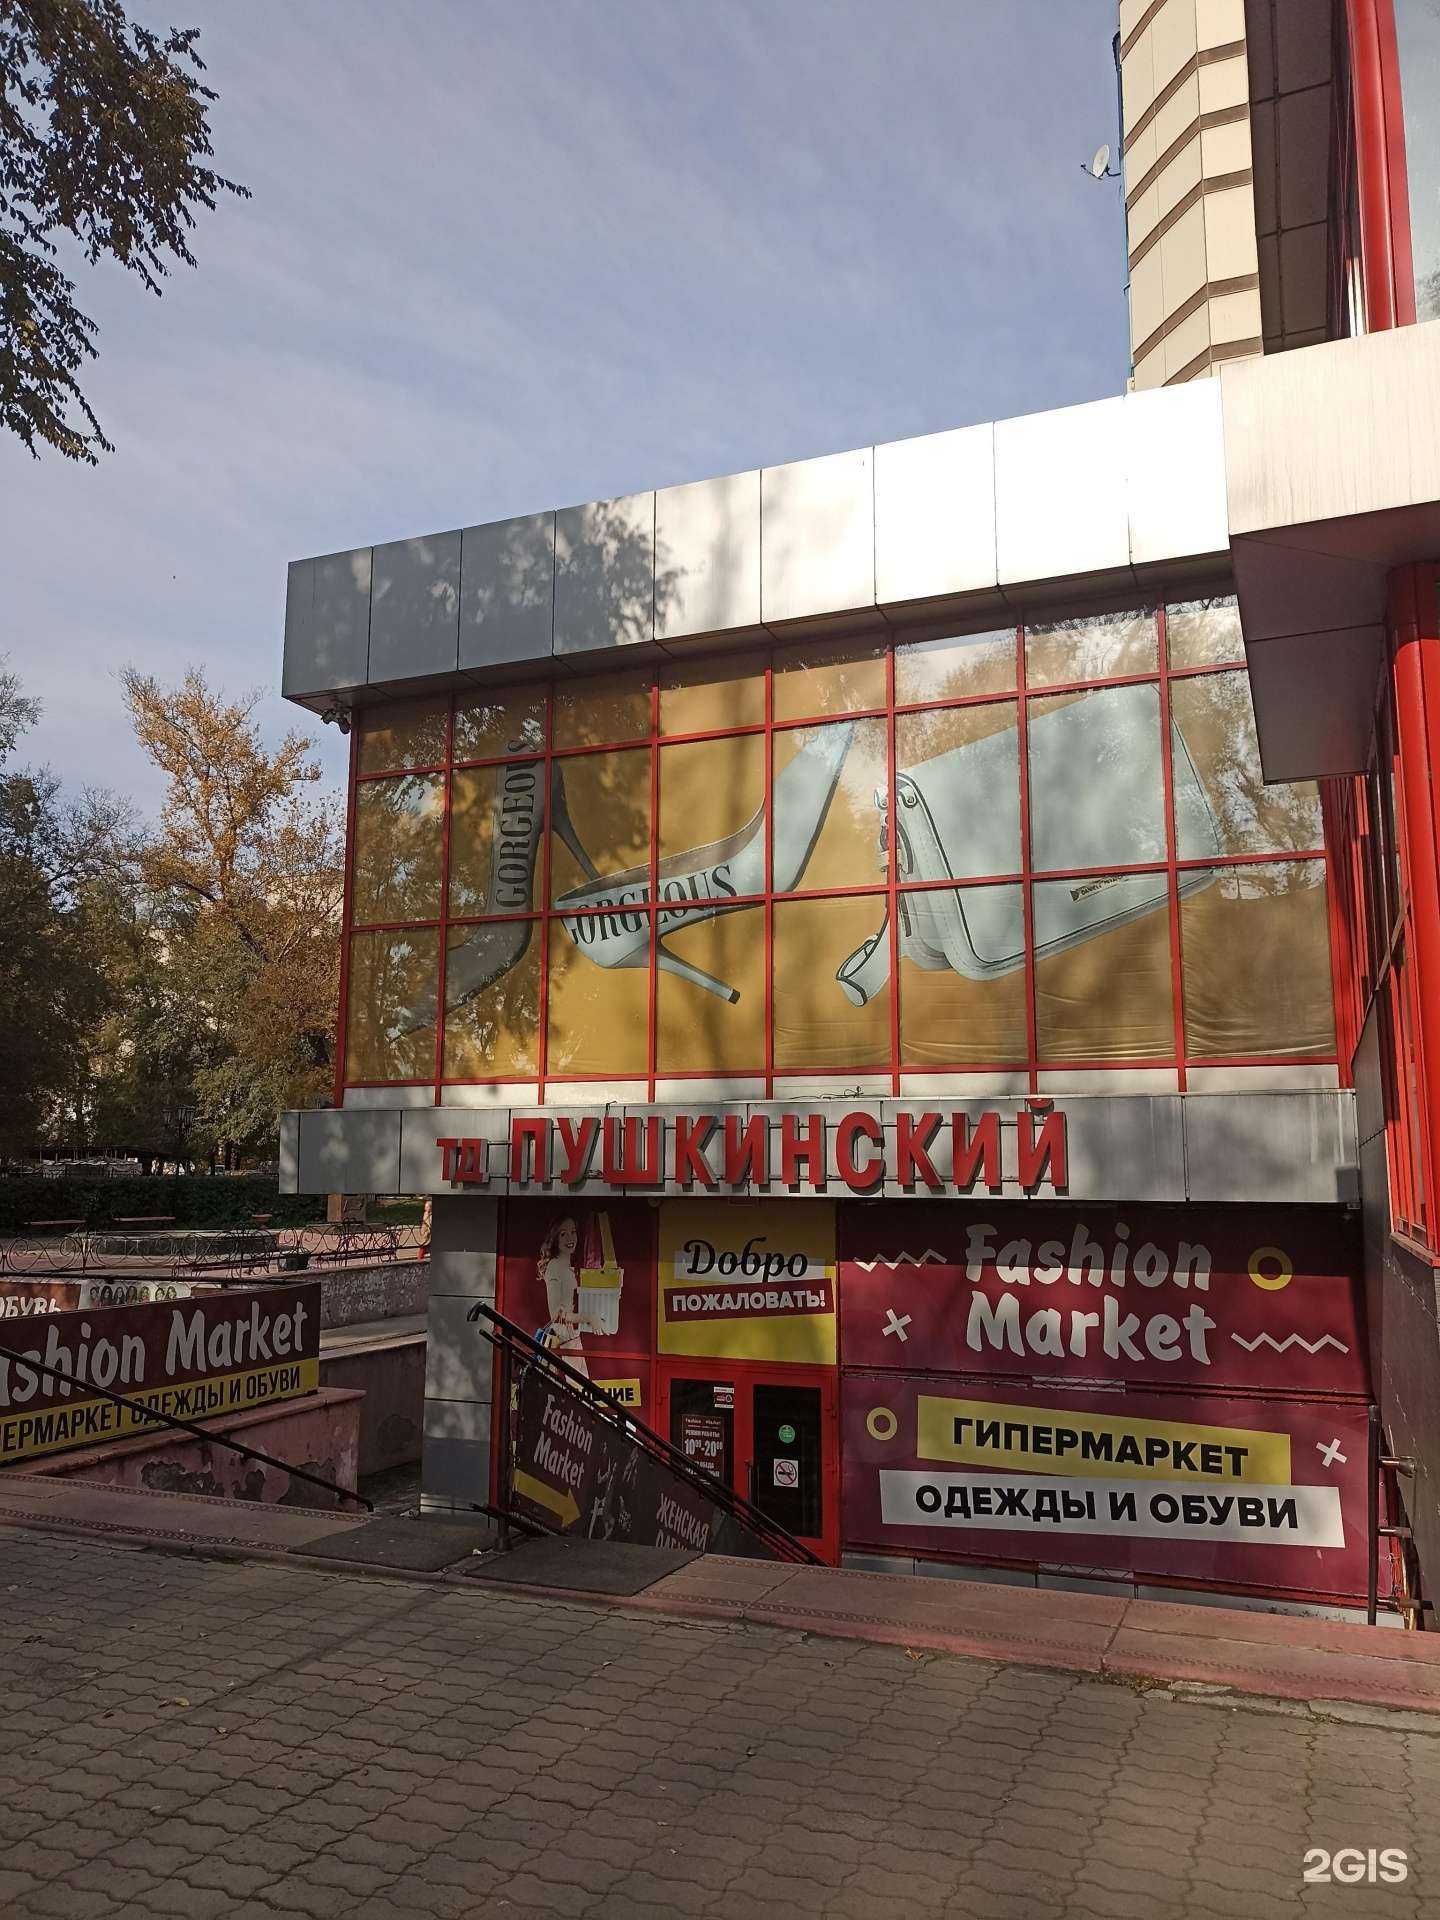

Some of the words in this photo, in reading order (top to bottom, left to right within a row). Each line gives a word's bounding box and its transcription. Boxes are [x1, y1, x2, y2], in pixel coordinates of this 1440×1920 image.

[512, 1099, 1069, 1190] ПУШКИНСКИЙ
[684, 1237, 809, 1282] Добро
[965, 1222, 1213, 1292] Fashion
[672, 1290, 826, 1312] ПОЖАЛОВАТЬ!
[965, 1290, 1217, 1365] Market
[165, 1300, 309, 1377] Market
[0, 1401, 122, 1450] ЕРМАРКЕТ
[246, 1366, 301, 1398] ОБУВИ
[542, 1393, 593, 1455] Fashion
[533, 1431, 584, 1488] Market
[953, 1417, 1249, 1477] ГИПЕРМАРКЕТ
[656, 1492, 710, 1552] ЖЕНСКАЯ
[915, 1485, 1096, 1523] ОДЕЖДЫ
[1109, 1492, 1137, 1521] И
[1149, 1493, 1299, 1529] ОБУВИ
